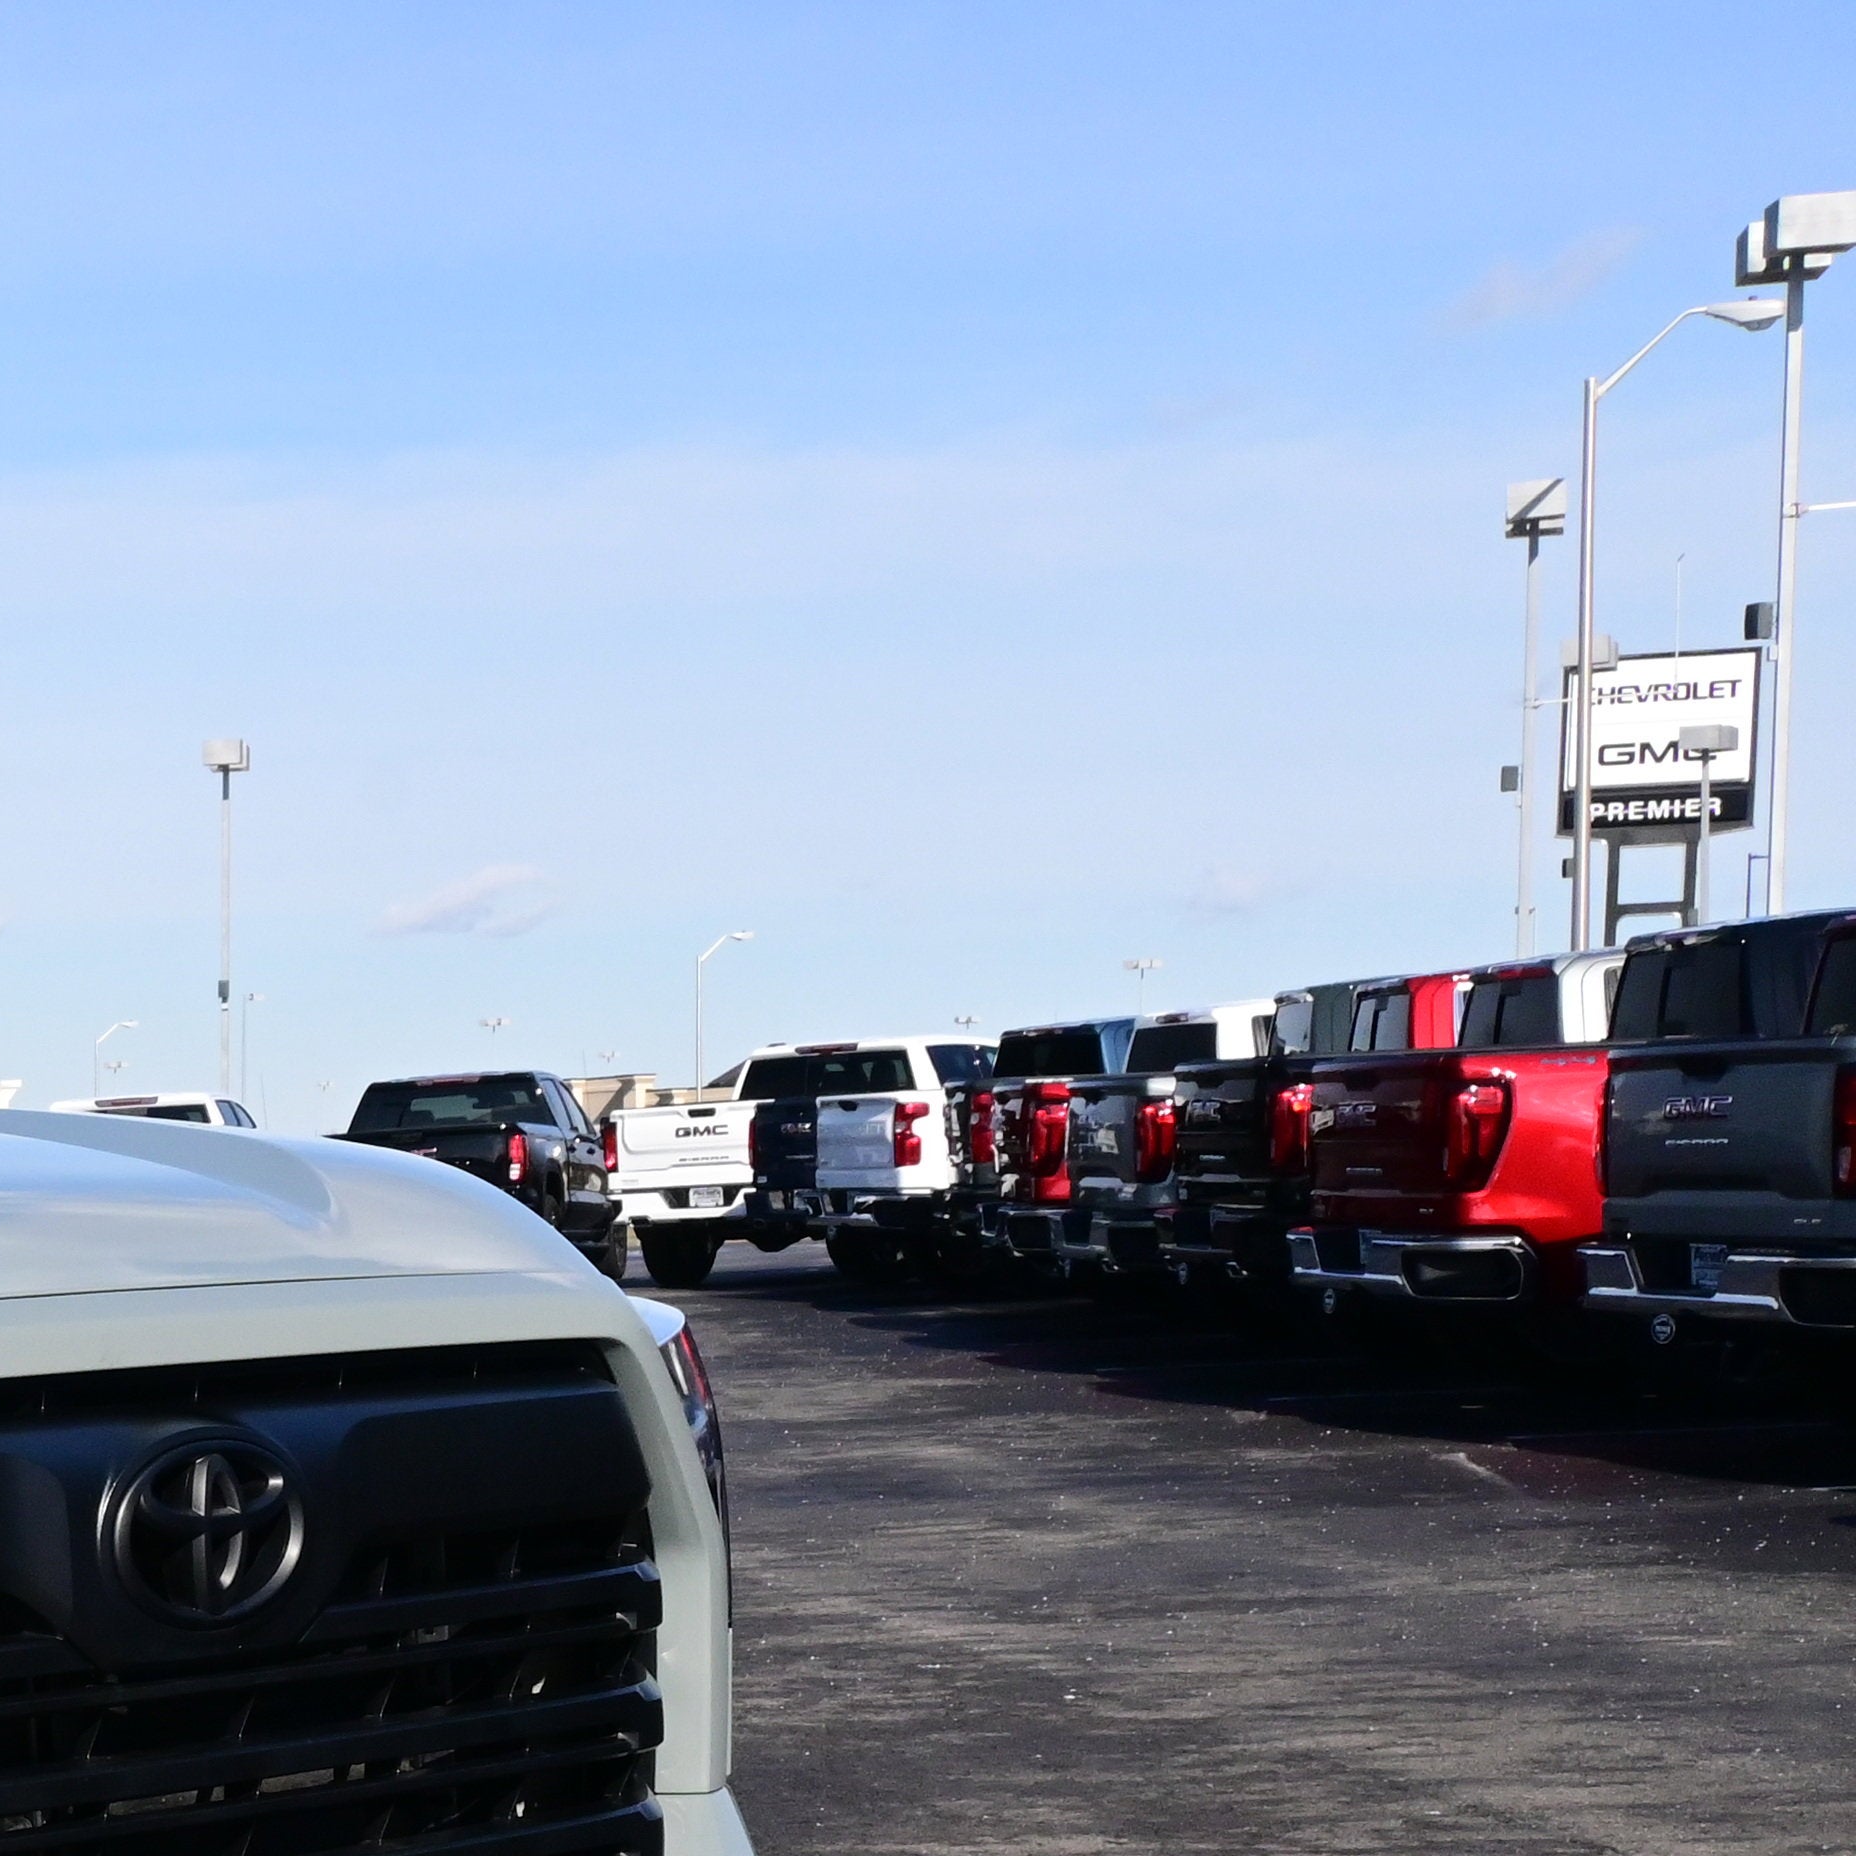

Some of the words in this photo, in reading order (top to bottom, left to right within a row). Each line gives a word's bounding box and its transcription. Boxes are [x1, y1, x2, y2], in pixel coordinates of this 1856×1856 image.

[1589, 797, 1722, 823] PREMIER
[1664, 1095, 1733, 1118] GMC
[675, 1124, 729, 1138] GMC
